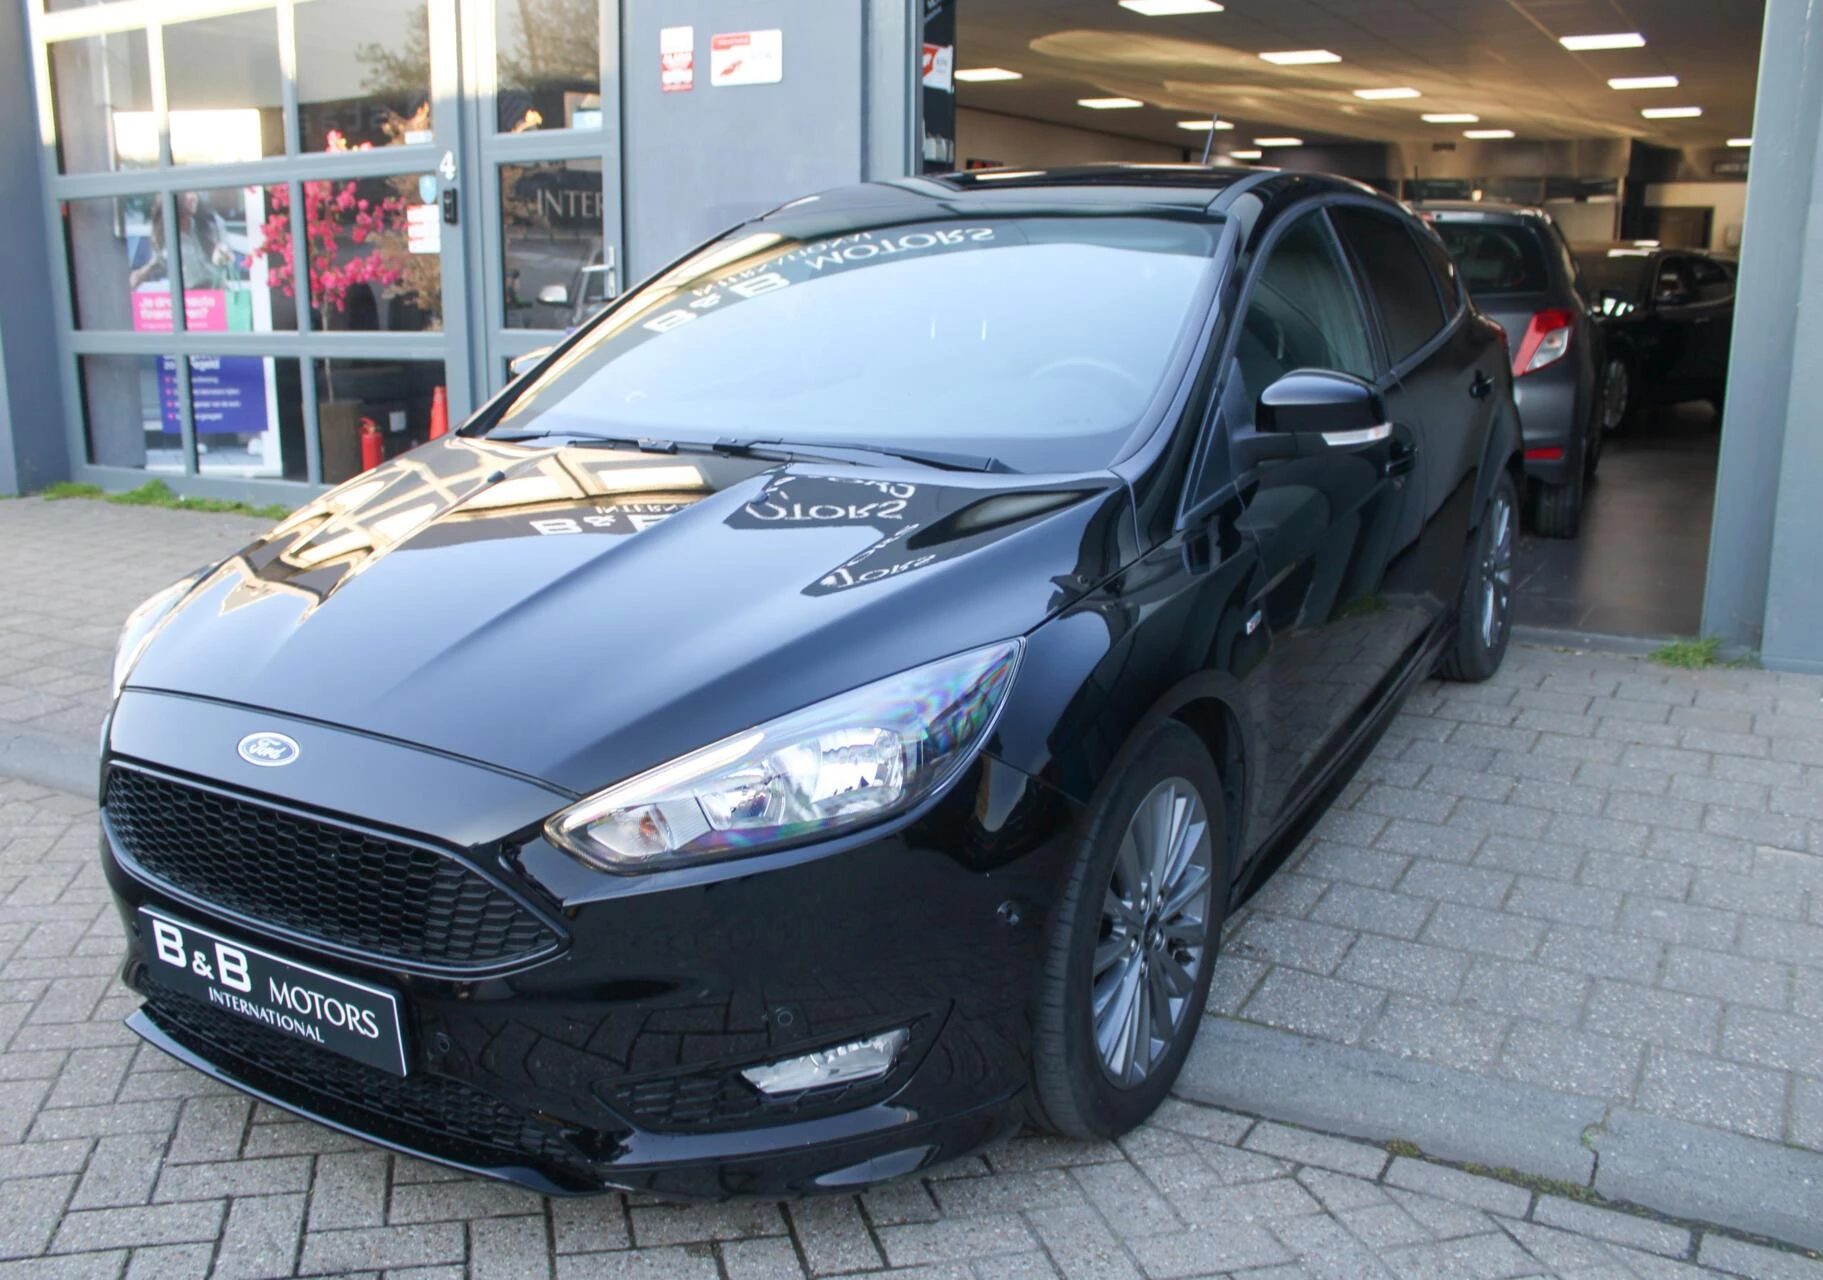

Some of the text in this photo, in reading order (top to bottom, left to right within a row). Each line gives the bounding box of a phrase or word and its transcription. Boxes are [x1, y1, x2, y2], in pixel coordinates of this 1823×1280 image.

[439, 150, 456, 181] 4
[248, 737, 287, 760] Ford
[152, 918, 380, 1039] B & B MOTORS
[209, 986, 326, 1044] INTERNATIONAL
